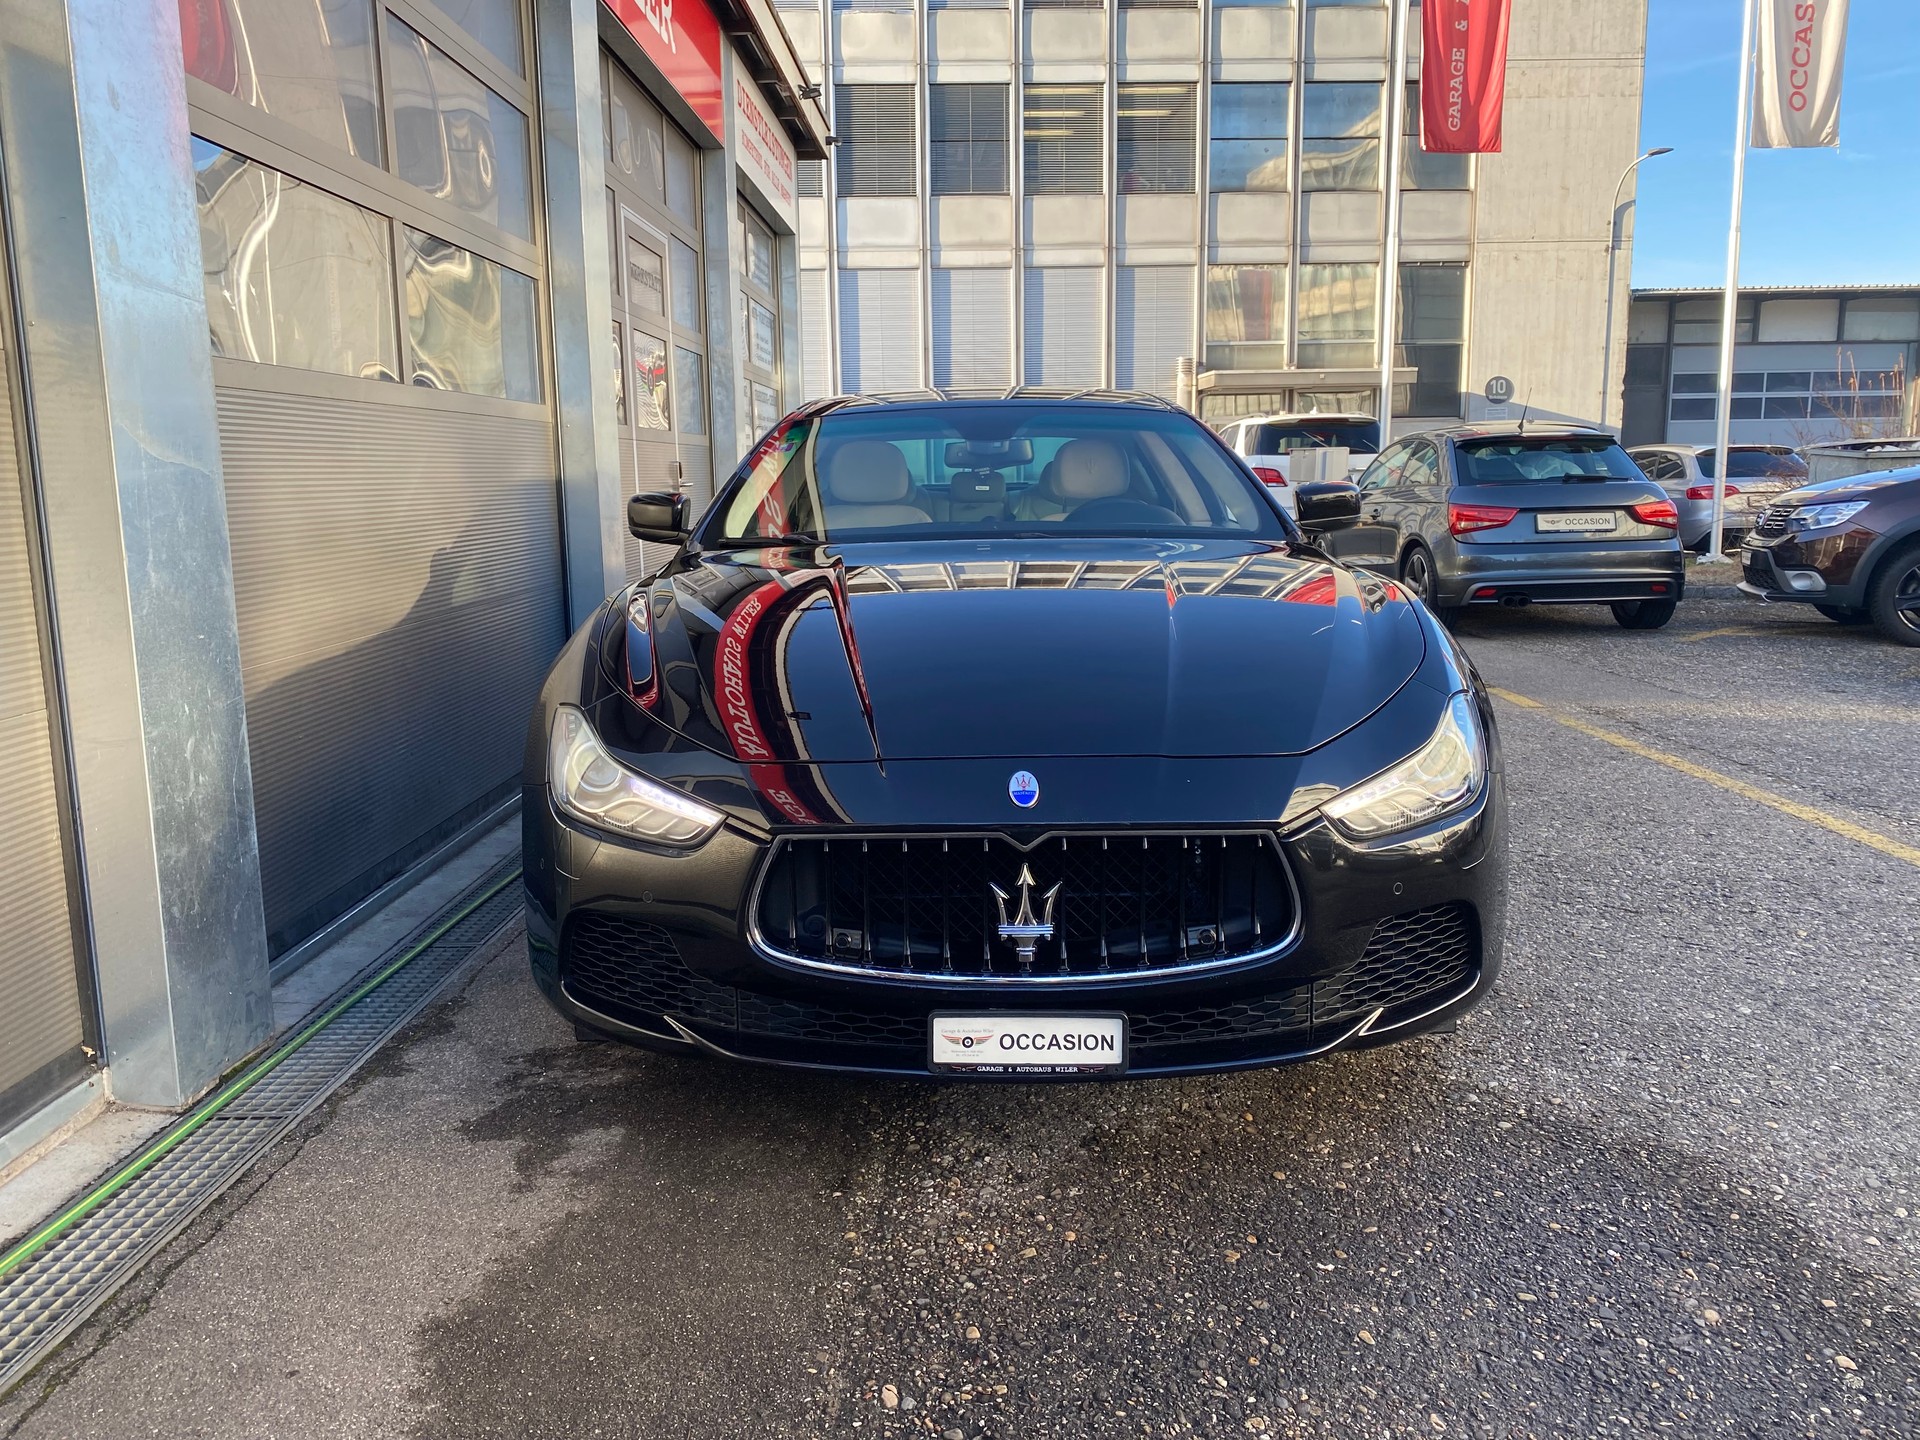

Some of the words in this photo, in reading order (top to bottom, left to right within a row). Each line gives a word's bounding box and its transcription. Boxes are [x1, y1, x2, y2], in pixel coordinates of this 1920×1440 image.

[1455, 20, 1468, 31] &
[1788, 3, 1816, 112] OCCAS
[1448, 48, 1466, 131] GARAGE
[1490, 379, 1506, 394] 10
[1564, 518, 1610, 526] OCCASION
[999, 1033, 1115, 1051] OCCASION
